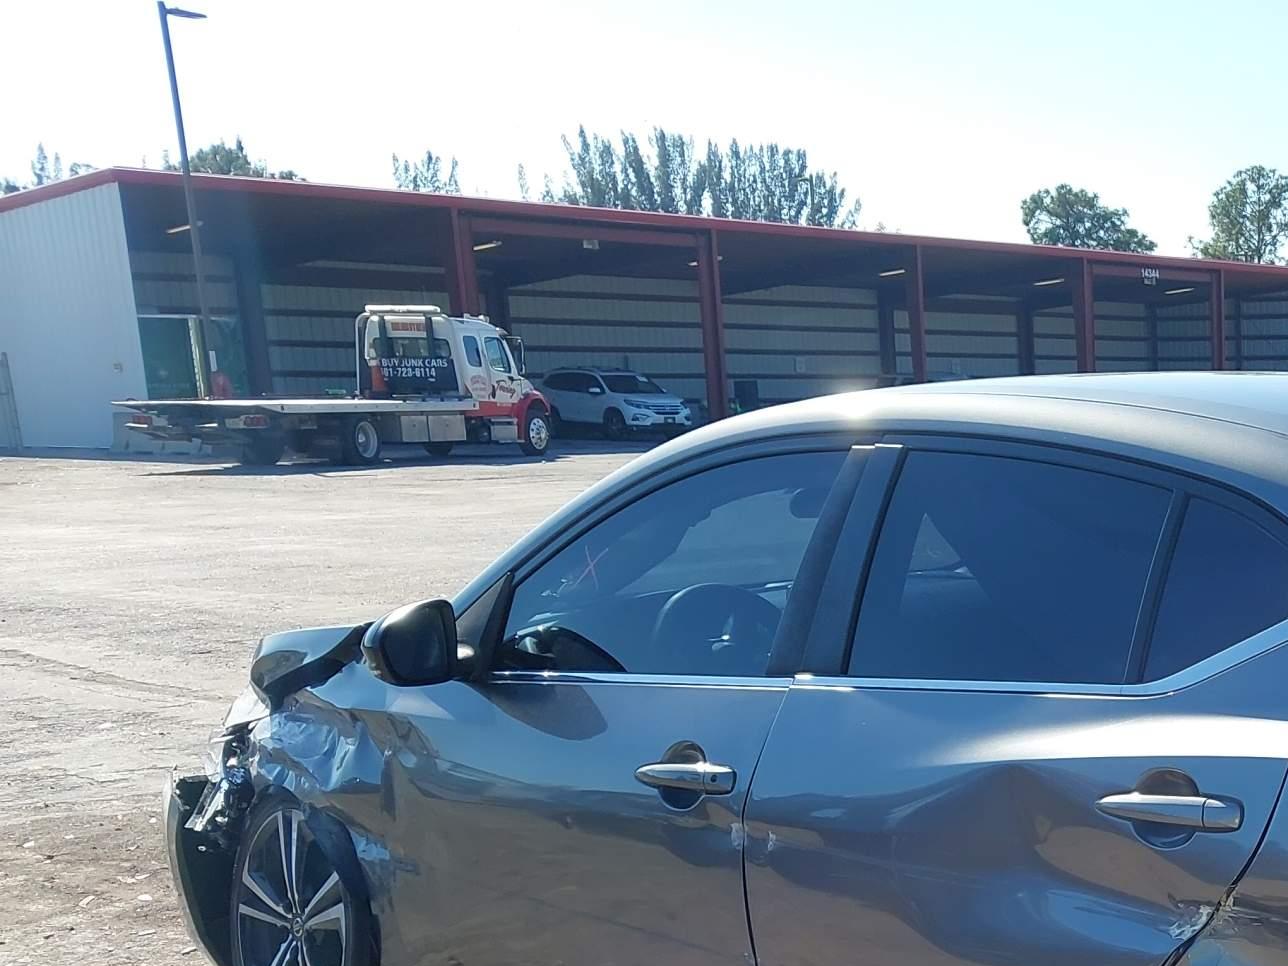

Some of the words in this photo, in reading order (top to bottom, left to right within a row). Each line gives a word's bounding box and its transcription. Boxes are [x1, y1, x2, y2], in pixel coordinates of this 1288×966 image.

[381, 358, 399, 367] BUY
[401, 358, 424, 367] JUNK
[425, 358, 448, 367] CARS
